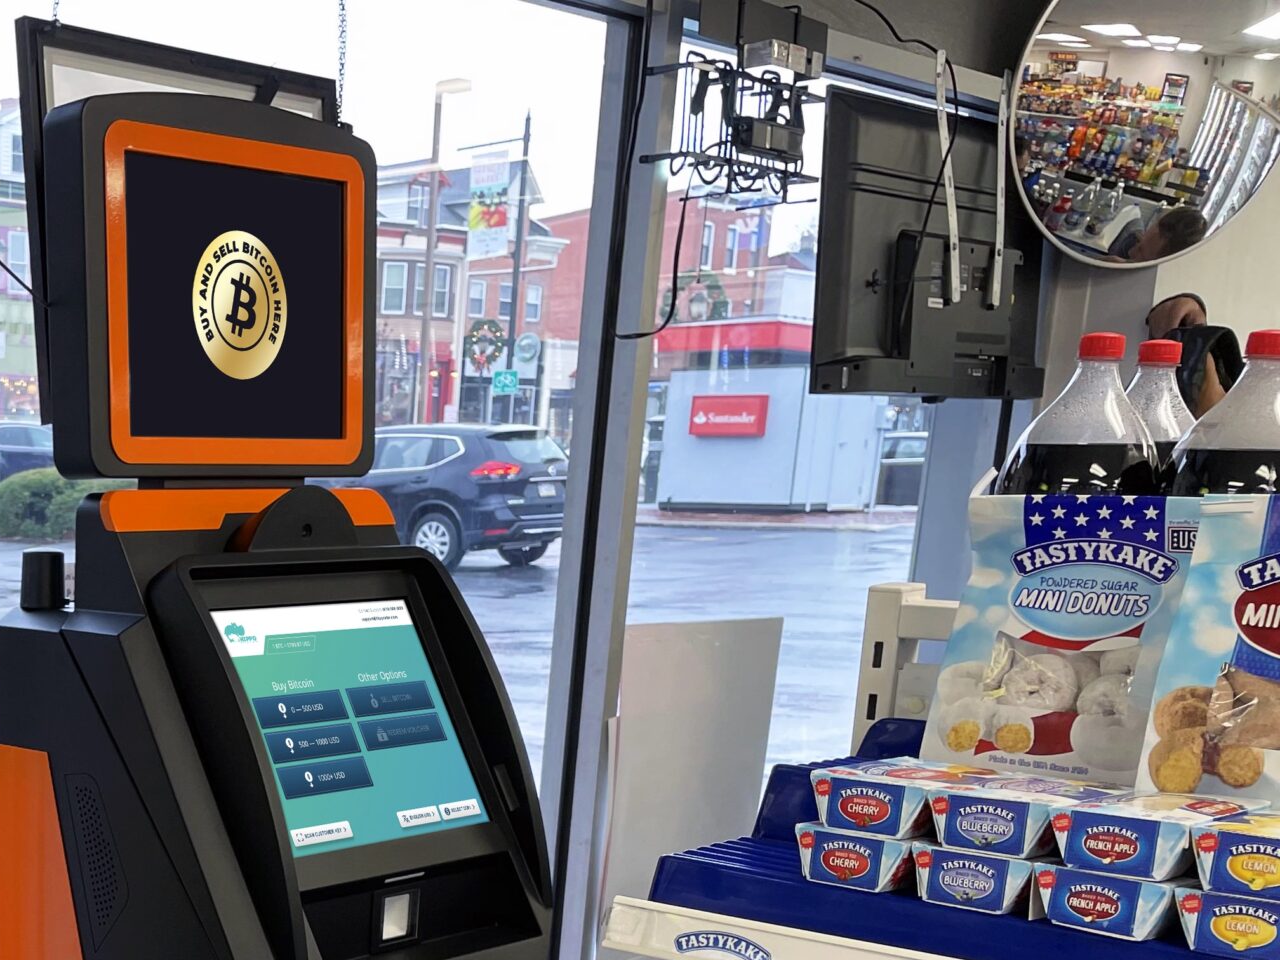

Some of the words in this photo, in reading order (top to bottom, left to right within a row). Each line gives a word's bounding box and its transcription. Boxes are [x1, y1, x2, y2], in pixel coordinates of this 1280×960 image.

[213, 240, 239, 263] SELL
[242, 242, 280, 294] BITCOIN
[200, 263, 213, 300] AND
[200, 306, 215, 343] BUY
[268, 300, 281, 345] HERE
[708, 412, 756, 424] Santander
[1017, 542, 1173, 583] TASTYKAKE
[1040, 576, 1097, 590] POWDERED
[1100, 578, 1139, 591] SUGAR
[1015, 588, 1066, 612] MINI
[1066, 593, 1150, 617] DONUTS
[358, 672, 378, 682] Other
[380, 669, 407, 681] Options
[272, 681, 287, 692] Buy
[288, 678, 314, 689] Bitcoin
[840, 787, 892, 803] TASTYKAKE
[847, 803, 880, 815] CHERRY
[959, 805, 1015, 821] TASTYKAKE
[961, 821, 1009, 835] BLUEBERRY
[1087, 825, 1139, 841] TASTYKAKE
[1086, 839, 1112, 851] FRENCH
[1114, 843, 1135, 855] APPLE
[1215, 907, 1278, 925] TASTYKAKE
[1225, 921, 1260, 934] LEMON
